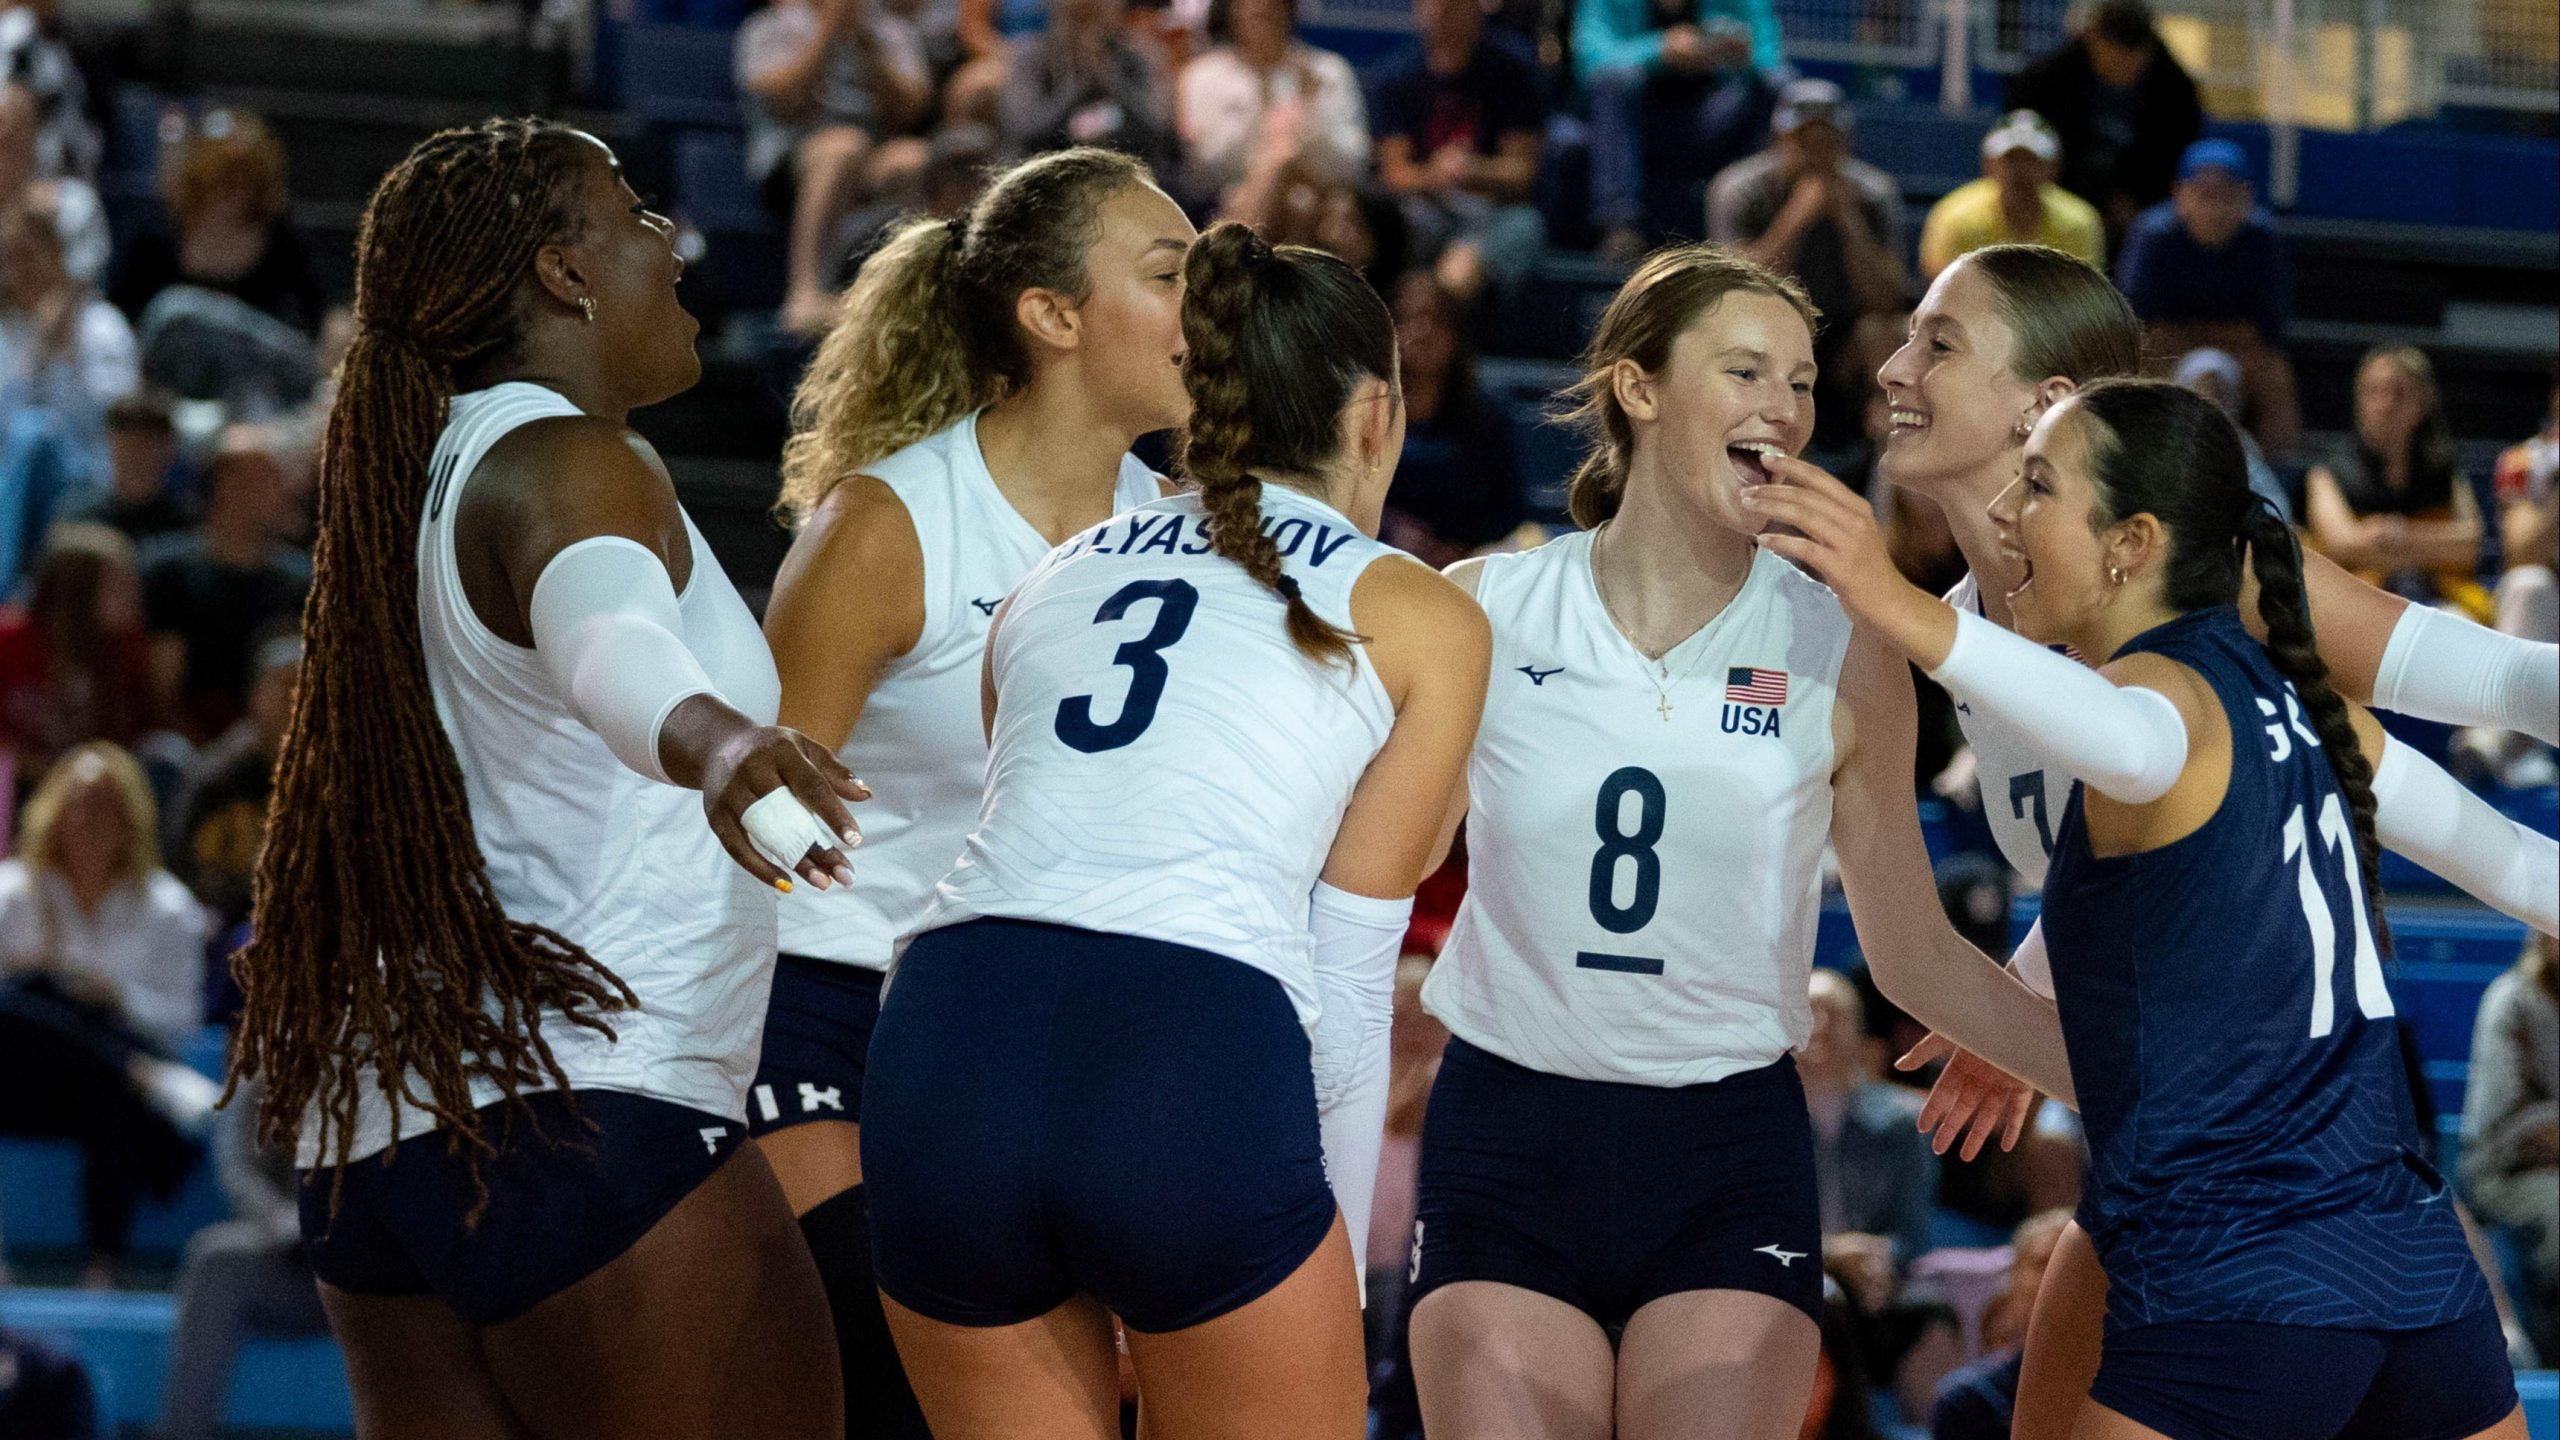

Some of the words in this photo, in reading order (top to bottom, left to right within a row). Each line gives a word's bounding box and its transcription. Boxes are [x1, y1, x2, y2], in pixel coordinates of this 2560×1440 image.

[1054, 578, 1200, 754] 3
[1720, 703, 1781, 738] USA
[1588, 766, 1667, 934] 8
[2009, 769, 2055, 860] 7
[2283, 792, 2396, 1040] 11
